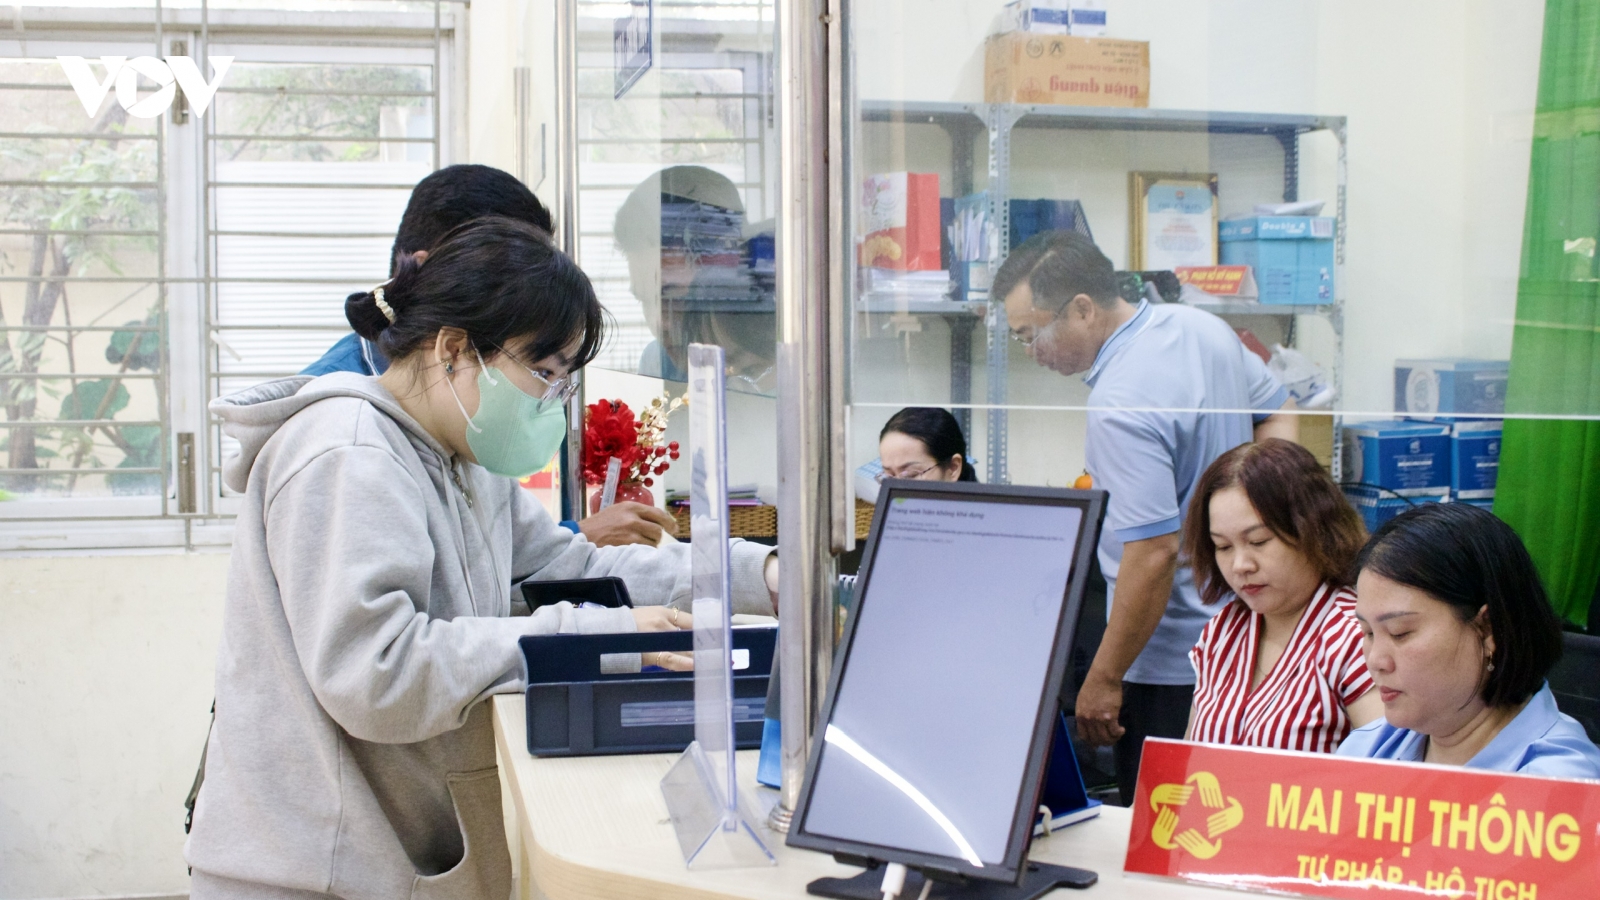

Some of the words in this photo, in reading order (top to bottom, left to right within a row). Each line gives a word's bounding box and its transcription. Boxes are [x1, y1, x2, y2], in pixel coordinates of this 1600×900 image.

[1266, 783, 1342, 834] MAI
[1355, 792, 1416, 858] THỊ
[1429, 793, 1581, 862] THÔNG
[1333, 858, 1403, 891] PHÁP
